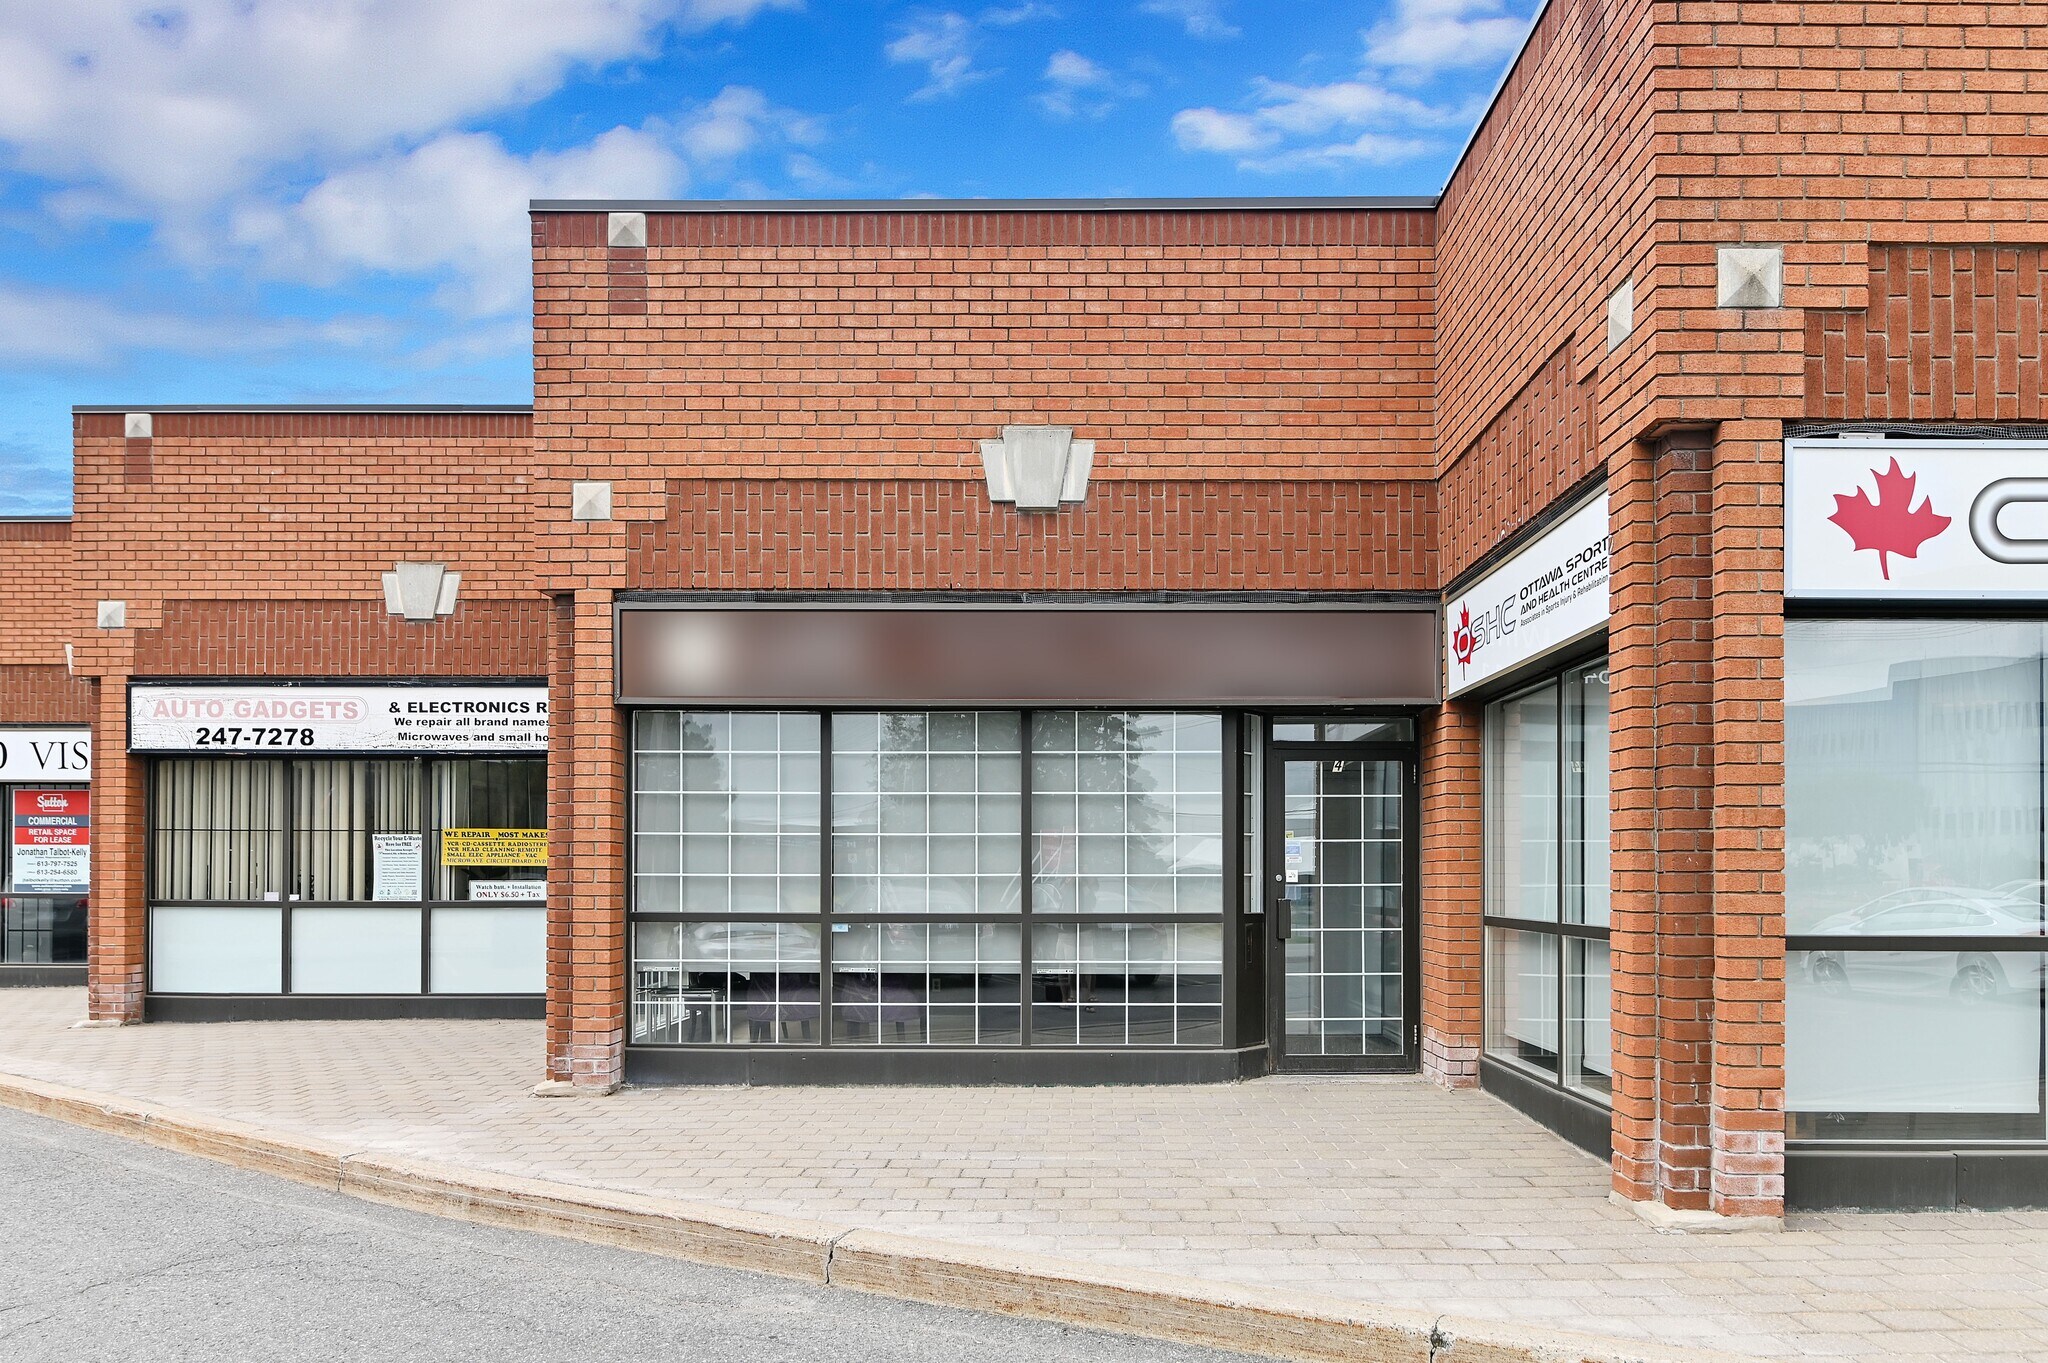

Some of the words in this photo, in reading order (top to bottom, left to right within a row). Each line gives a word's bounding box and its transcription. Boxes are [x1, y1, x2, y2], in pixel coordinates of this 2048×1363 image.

[1519, 566, 1563, 600] OTTAWA
[1520, 598, 1537, 616] AND
[1538, 578, 1570, 605] HEALTH
[1571, 556, 1608, 586] CENTRE
[1520, 611, 1541, 627] Associates
[1545, 601, 1560, 614] Sports
[1560, 594, 1572, 607] Injury
[1577, 574, 1608, 597] Rehabilitation
[153, 699, 225, 718] AUTO
[233, 700, 359, 720] GADGETS
[388, 701, 401, 714] &
[407, 701, 531, 714] ELECTRONICS
[394, 717, 413, 727] We
[416, 717, 452, 728] repair
[455, 717, 470, 727] all
[474, 717, 509, 727] brand
[195, 727, 315, 747] 247-7278
[397, 732, 469, 742] Microwaves
[473, 732, 495, 742] and
[499, 732, 531, 742] small
[29, 741, 88, 770] VIS
[1334, 761, 1343, 772] 4
[37, 795, 69, 808] Sutton
[28, 816, 77, 826] COMMERCIAL
[28, 828, 53, 836] RETAIL
[54, 828, 77, 836] SPACE
[16, 847, 48, 856] Jonathan
[49, 847, 87, 858] Talbot-Kelly
[476, 891, 499, 899] ONLY
[526, 890, 541, 898] Tax
